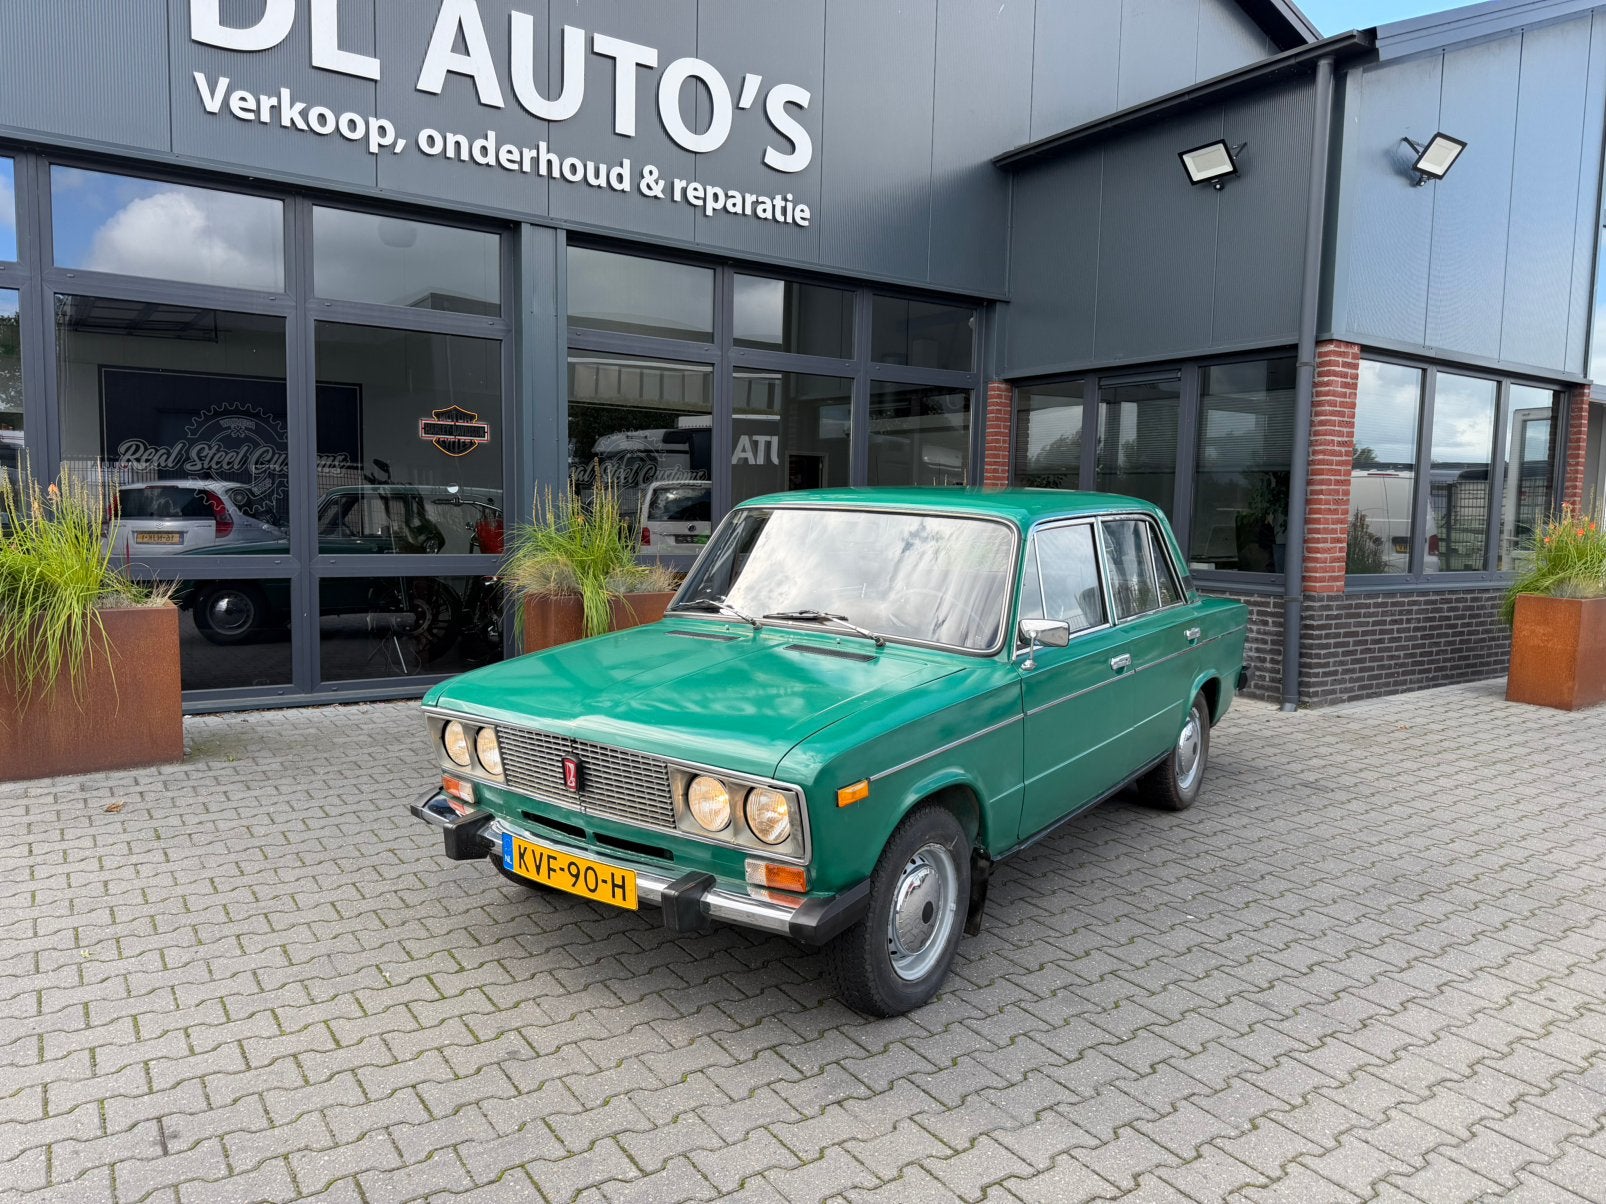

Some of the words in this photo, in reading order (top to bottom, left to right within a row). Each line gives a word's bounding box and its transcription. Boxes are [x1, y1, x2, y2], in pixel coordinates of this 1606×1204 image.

[416, 0, 813, 173] AUTO'S
[193, 70, 406, 155] Verkoop,
[417, 127, 632, 193] onderhoud
[639, 165, 665, 199] &
[672, 179, 811, 227] reparatie
[119, 439, 186, 472] Real
[185, 442, 251, 473] Steel
[518, 844, 627, 902] KVF-90-H
